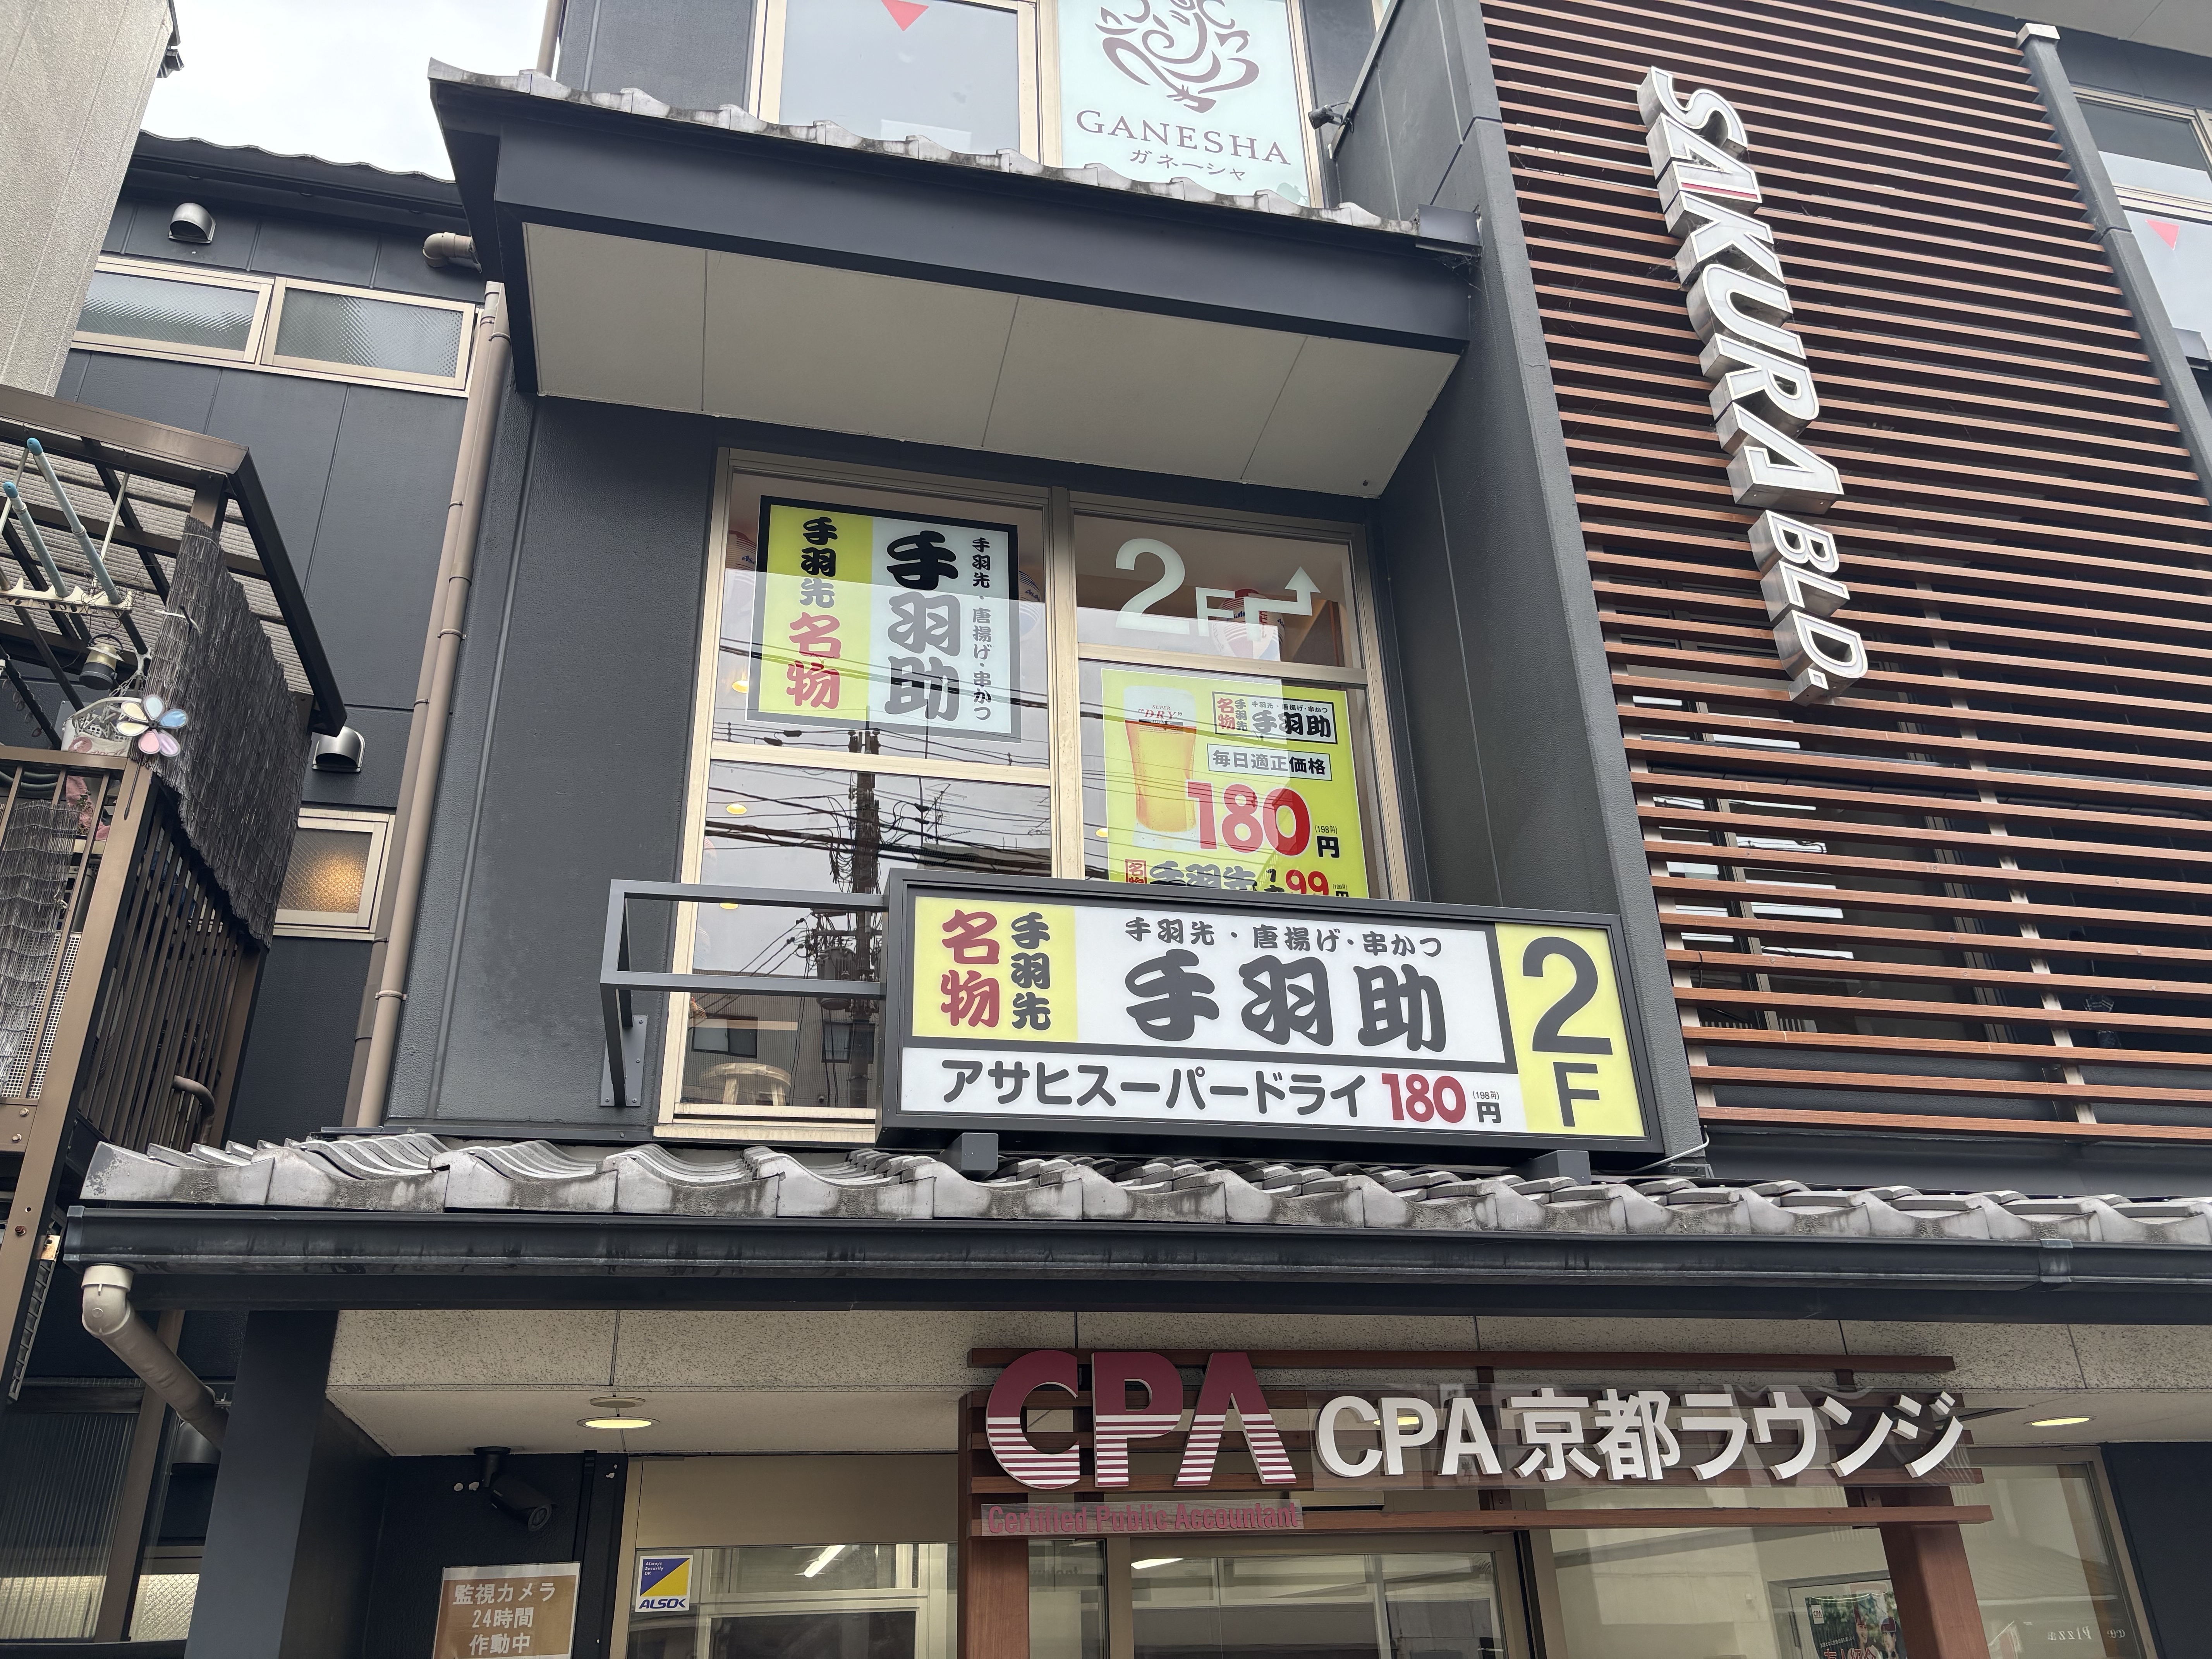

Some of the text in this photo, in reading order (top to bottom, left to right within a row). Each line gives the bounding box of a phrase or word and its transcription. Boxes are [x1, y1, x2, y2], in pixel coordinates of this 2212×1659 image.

[1077, 110, 1291, 165] GANESHA
[1130, 149, 1245, 181] ガネーシャ
[1637, 66, 1844, 514] SAKURA
[1116, 538, 1235, 637] 2F
[1748, 510, 1868, 706] BLD.
[884, 530, 961, 721] 手羽助
[972, 537, 992, 721] 手羽先・唐揚げ・串かつ
[1217, 697, 1235, 730] 名物
[1235, 699, 1248, 731] 手羽先
[1252, 710, 1331, 738] 手羽助
[1212, 750, 1326, 775] 毎日適正価格
[1187, 781, 1310, 856] 180
[1317, 836, 1340, 858] 円
[1286, 869, 1329, 895] 99
[1125, 917, 1442, 957] 手羽先・唐揚げ・串かつ
[941, 909, 1000, 1028] 名物
[1011, 912, 1051, 1030] 手羽先
[1125, 948, 1446, 1053] 手羽助
[1522, 936, 1613, 1127] 2F
[942, 1060, 1366, 1118] アサヒスーパードライ
[1381, 1073, 1467, 1123] 180
[1476, 1102, 1502, 1123] 円
[986, 1350, 1298, 1489] CPA
[1317, 1387, 1963, 1481] CPA 京都ラウンジ
[988, 1502, 1298, 1534] Certified Public Accountant
[453, 1582, 556, 1605] 監視カメラ
[472, 1607, 534, 1629] 24時間
[639, 1598, 686, 1609] ALSOK
[469, 1633, 531, 1656] 作動中
